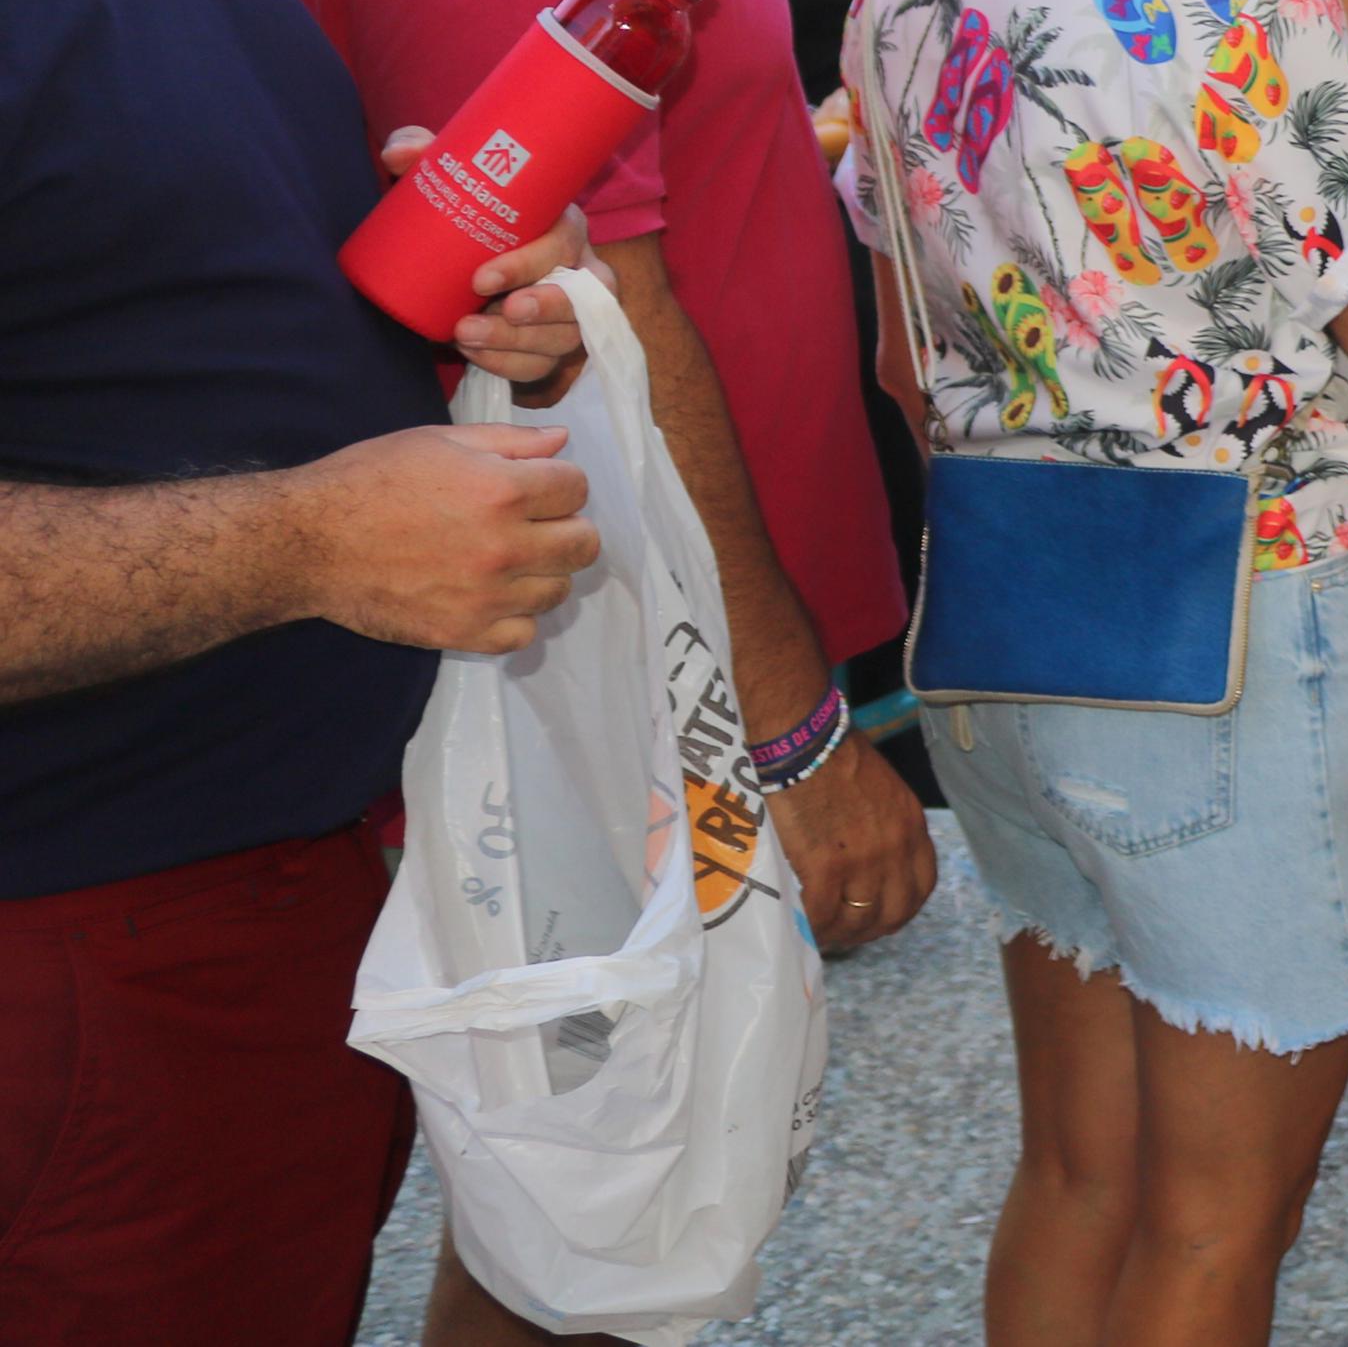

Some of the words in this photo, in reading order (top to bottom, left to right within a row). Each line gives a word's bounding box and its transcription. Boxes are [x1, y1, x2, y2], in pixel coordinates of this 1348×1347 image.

[437, 152, 520, 224] salesianos
[461, 204, 478, 220] DE
[451, 215, 506, 253] ASTUDILLO
[792, 726, 811, 747] DE
